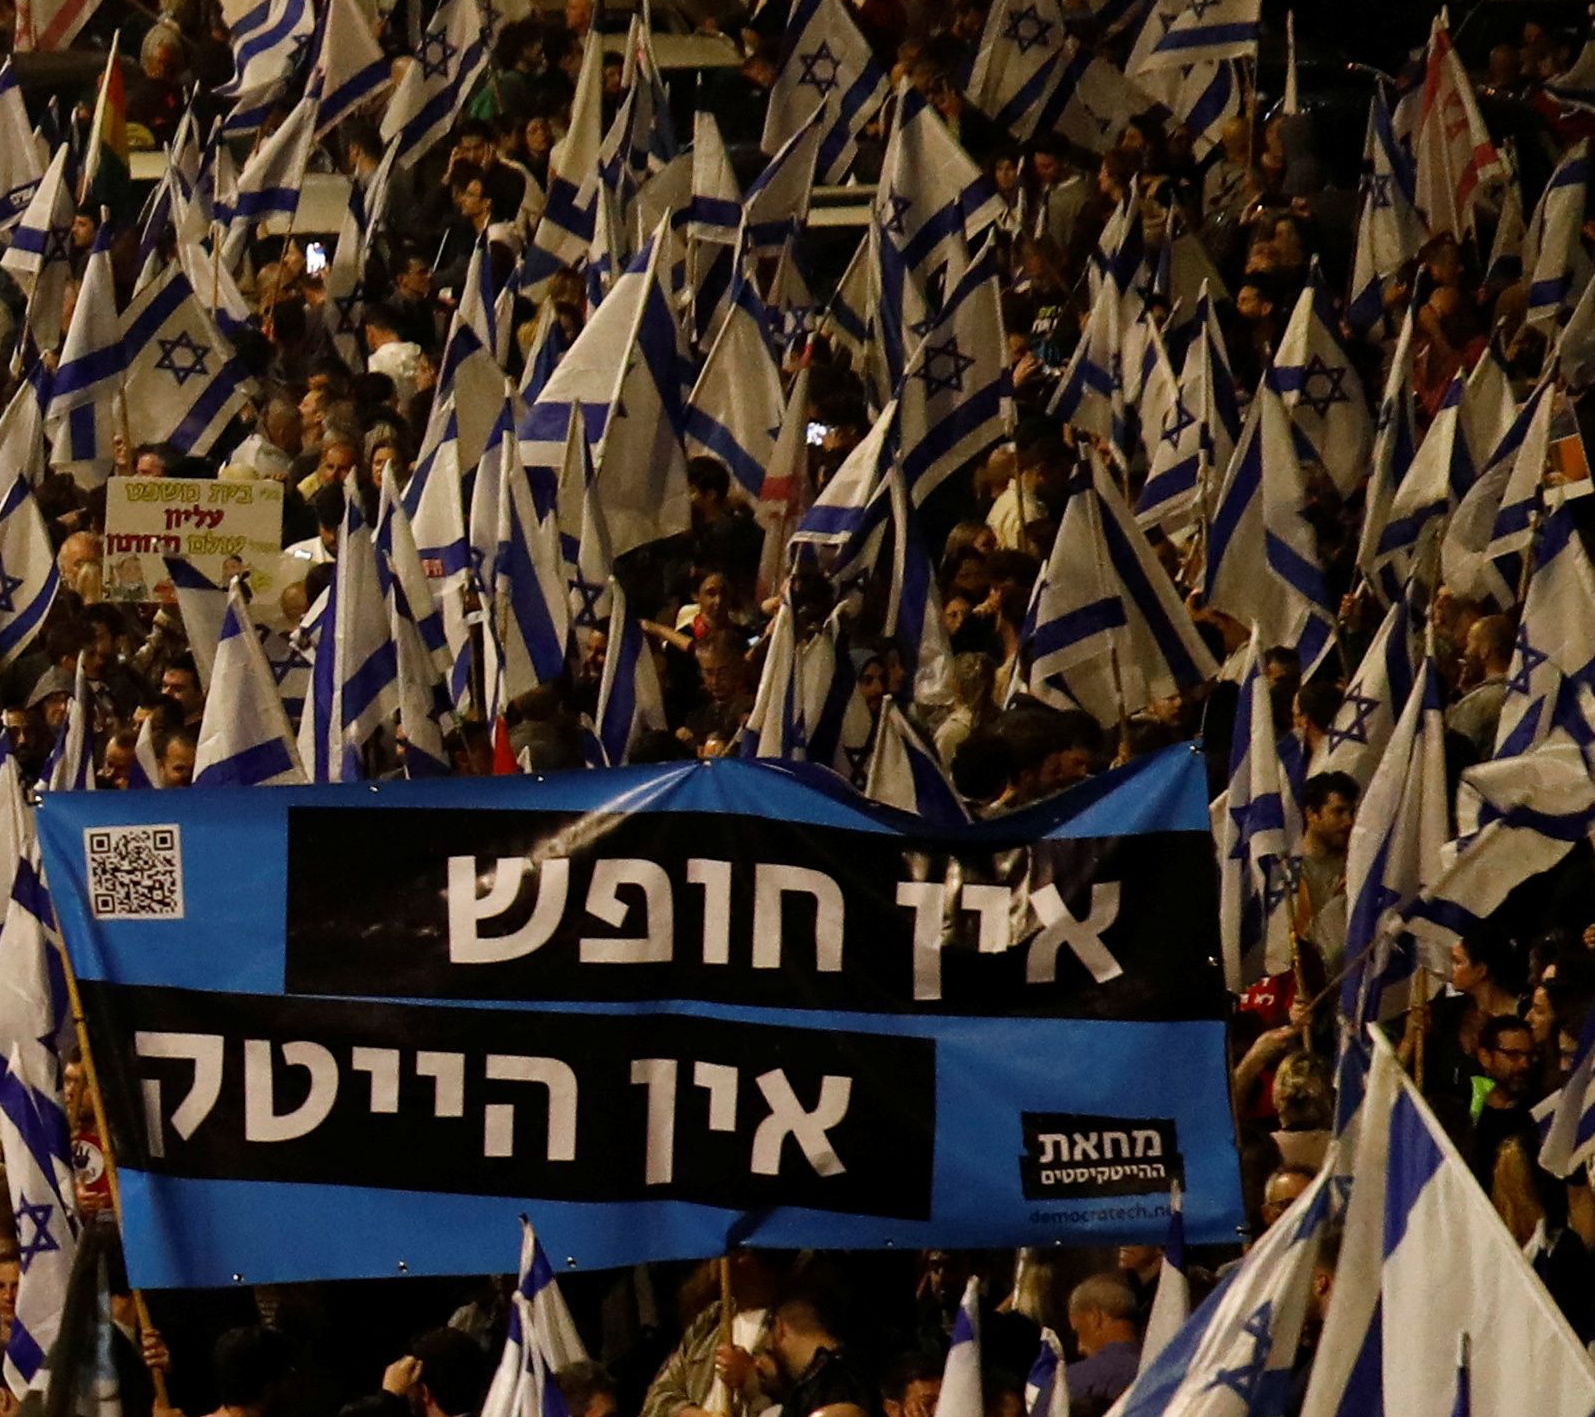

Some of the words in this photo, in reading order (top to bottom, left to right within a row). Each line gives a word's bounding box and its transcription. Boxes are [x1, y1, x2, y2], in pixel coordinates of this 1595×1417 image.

[125, 482, 201, 503] משפט
[207, 484, 253, 504] בית
[164, 504, 225, 530] עליון
[448, 852, 844, 971] חופש
[897, 879, 1125, 1001] אין
[135, 1030, 578, 1160] הייטק
[632, 1057, 853, 1185] אין
[1037, 1129, 1163, 1164] מחאת
[1040, 1163, 1166, 1185] ההייטקיסטים
